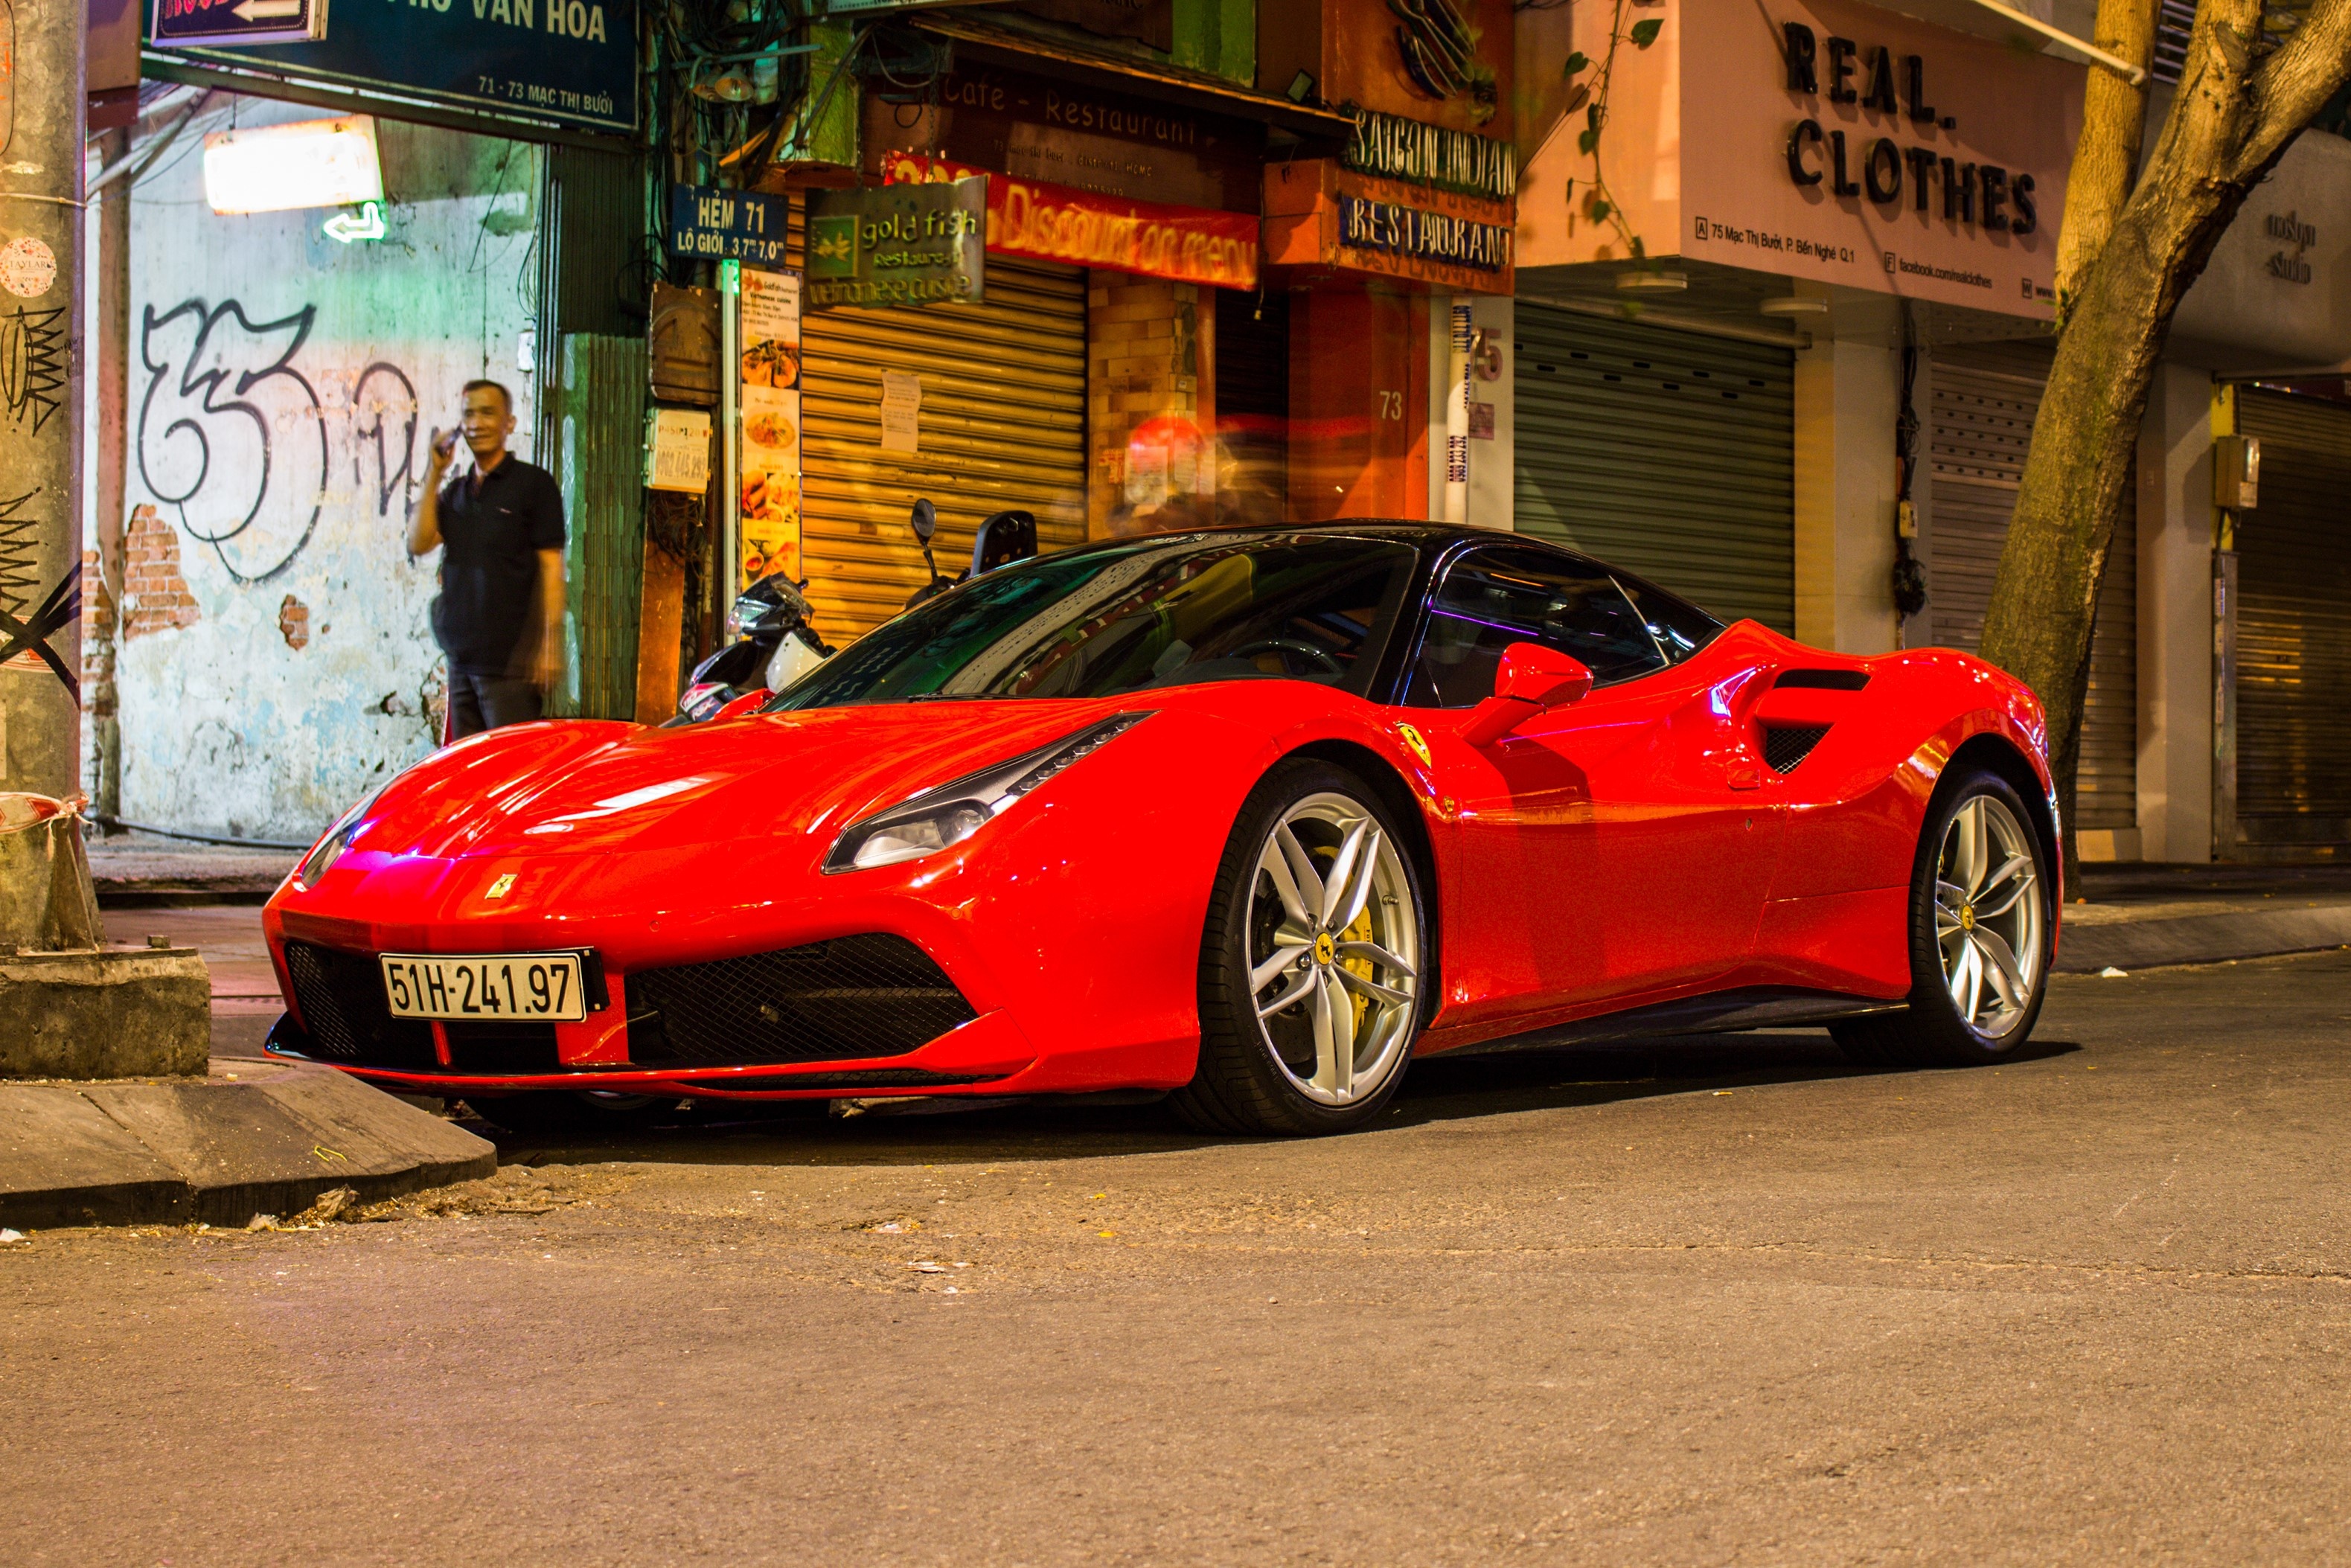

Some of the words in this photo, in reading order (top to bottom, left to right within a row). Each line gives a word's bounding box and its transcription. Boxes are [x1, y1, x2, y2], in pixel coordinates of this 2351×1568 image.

[479, 76, 495, 95] 71
[508, 81, 525, 99] 73
[528, 84, 556, 108] MẠC
[560, 90, 580, 112] THỊ
[1783, 21, 1957, 129] REAL.
[1046, 89, 1195, 144] Restaurant
[1350, 109, 1438, 179] SAIGON
[1443, 130, 1517, 196] INDIAN
[1787, 119, 2037, 234] CLOTHES
[698, 189, 735, 229] HẺM
[746, 202, 765, 234] 71
[862, 213, 918, 250] gold
[1006, 183, 1139, 268] Discount
[1181, 231, 1258, 287] menu
[1349, 196, 1515, 267] RESTAURANT
[677, 227, 694, 255] LỘ
[1712, 224, 1724, 239] 75
[1725, 225, 1744, 245] Mạc
[1745, 229, 1759, 249] Thị
[1814, 243, 1837, 262] Nghé
[1380, 391, 1402, 420] 73
[388, 964, 570, 1013] 51H-241.97
